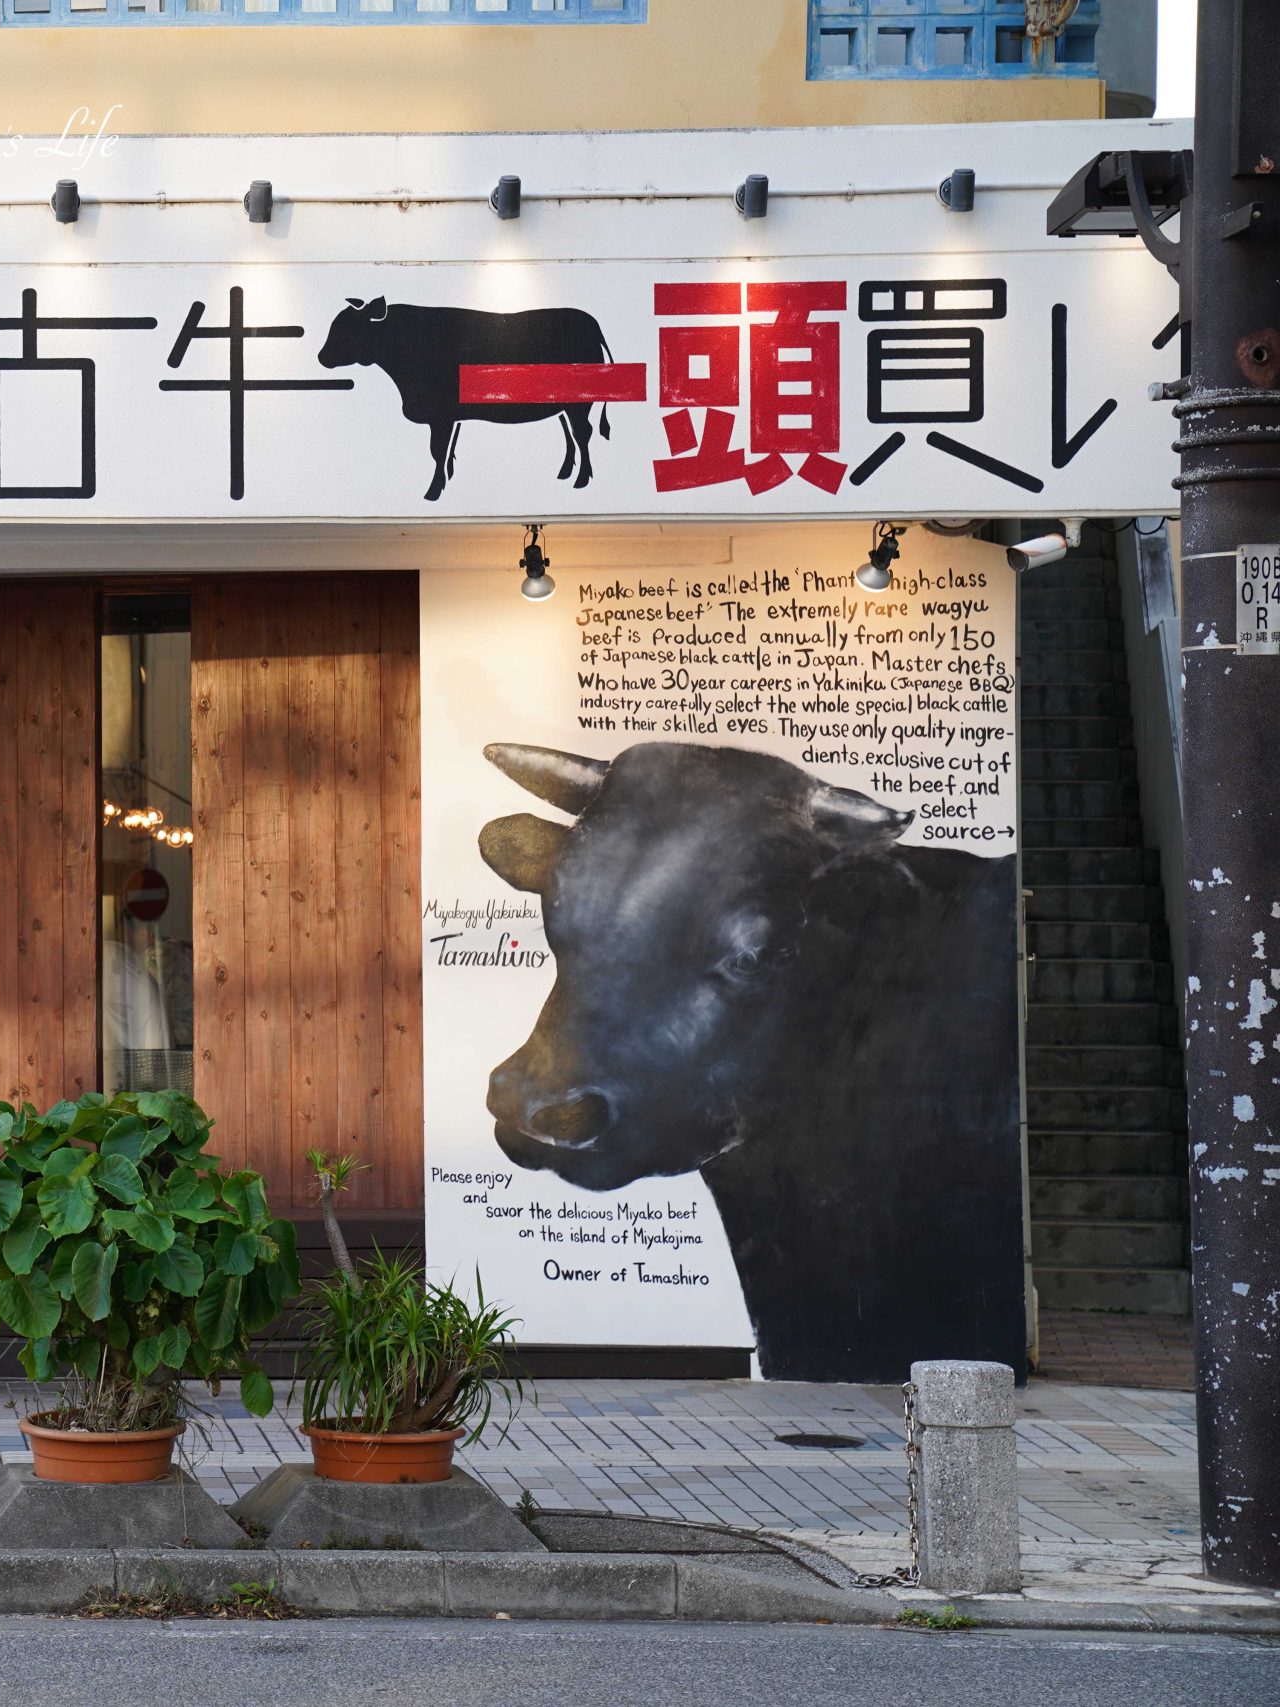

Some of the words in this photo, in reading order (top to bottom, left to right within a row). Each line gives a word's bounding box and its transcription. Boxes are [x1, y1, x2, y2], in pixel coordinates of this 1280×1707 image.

[578, 580, 634, 603] Miyako
[639, 578, 679, 598] beef
[686, 581, 702, 598] is
[708, 571, 758, 596] called
[761, 569, 790, 597] the
[1241, 582, 1280, 605] 0.14
[576, 608, 663, 626] Japanese
[719, 602, 756, 622] The
[767, 596, 858, 624] extremely
[922, 599, 989, 620] wagyu
[1256, 606, 1269, 630] R
[582, 626, 623, 646] beef
[628, 629, 641, 643] is
[759, 621, 848, 651] annually
[854, 624, 903, 644] from
[909, 622, 946, 649] only
[950, 624, 995, 651] 150
[581, 649, 598, 666] of
[602, 648, 676, 669] Japanese
[680, 647, 719, 665] black
[722, 646, 771, 671] cattle
[777, 651, 791, 665] in
[793, 649, 864, 670] Japan.
[872, 650, 943, 672] Master
[947, 654, 1006, 676] chefs
[621, 674, 657, 691] have
[661, 668, 689, 690] 30
[691, 676, 726, 693] year
[730, 677, 793, 693] careers
[797, 675, 809, 691] in
[812, 668, 886, 694] Yakiniku
[890, 676, 963, 693] (Japanese
[969, 674, 1015, 694] BBQ)
[580, 693, 642, 715] industry
[645, 692, 711, 716] carefully
[715, 692, 762, 714] select
[766, 694, 796, 714] the
[802, 693, 850, 714] whole
[855, 694, 912, 715] special
[917, 693, 960, 712] black
[963, 694, 1008, 713] cattle
[622, 716, 657, 731] their
[662, 713, 718, 734] skilled
[777, 717, 817, 742] They
[820, 722, 849, 738] use
[852, 714, 887, 744] only
[891, 713, 956, 747] quality
[960, 722, 1014, 747] ingre-
[948, 752, 983, 774] cut
[988, 751, 1012, 774] of
[870, 772, 903, 793] the
[922, 824, 996, 840] source
[430, 932, 550, 969] Tamashiro
[430, 1167, 472, 1184] Please
[475, 1168, 513, 1190] enjoy
[463, 1191, 488, 1204] and
[485, 1205, 524, 1218] savor
[529, 1202, 552, 1220] the
[557, 1202, 613, 1221] delicious
[617, 1202, 663, 1226] Miyako
[667, 1201, 698, 1220] beef
[519, 1227, 535, 1239] on
[540, 1225, 564, 1243] the
[570, 1226, 605, 1244] island
[611, 1229, 629, 1245] of
[633, 1227, 703, 1250] Miyakojima
[543, 1259, 601, 1282] Owner
[610, 1265, 627, 1282] of
[633, 1262, 710, 1286] Tamashiro
